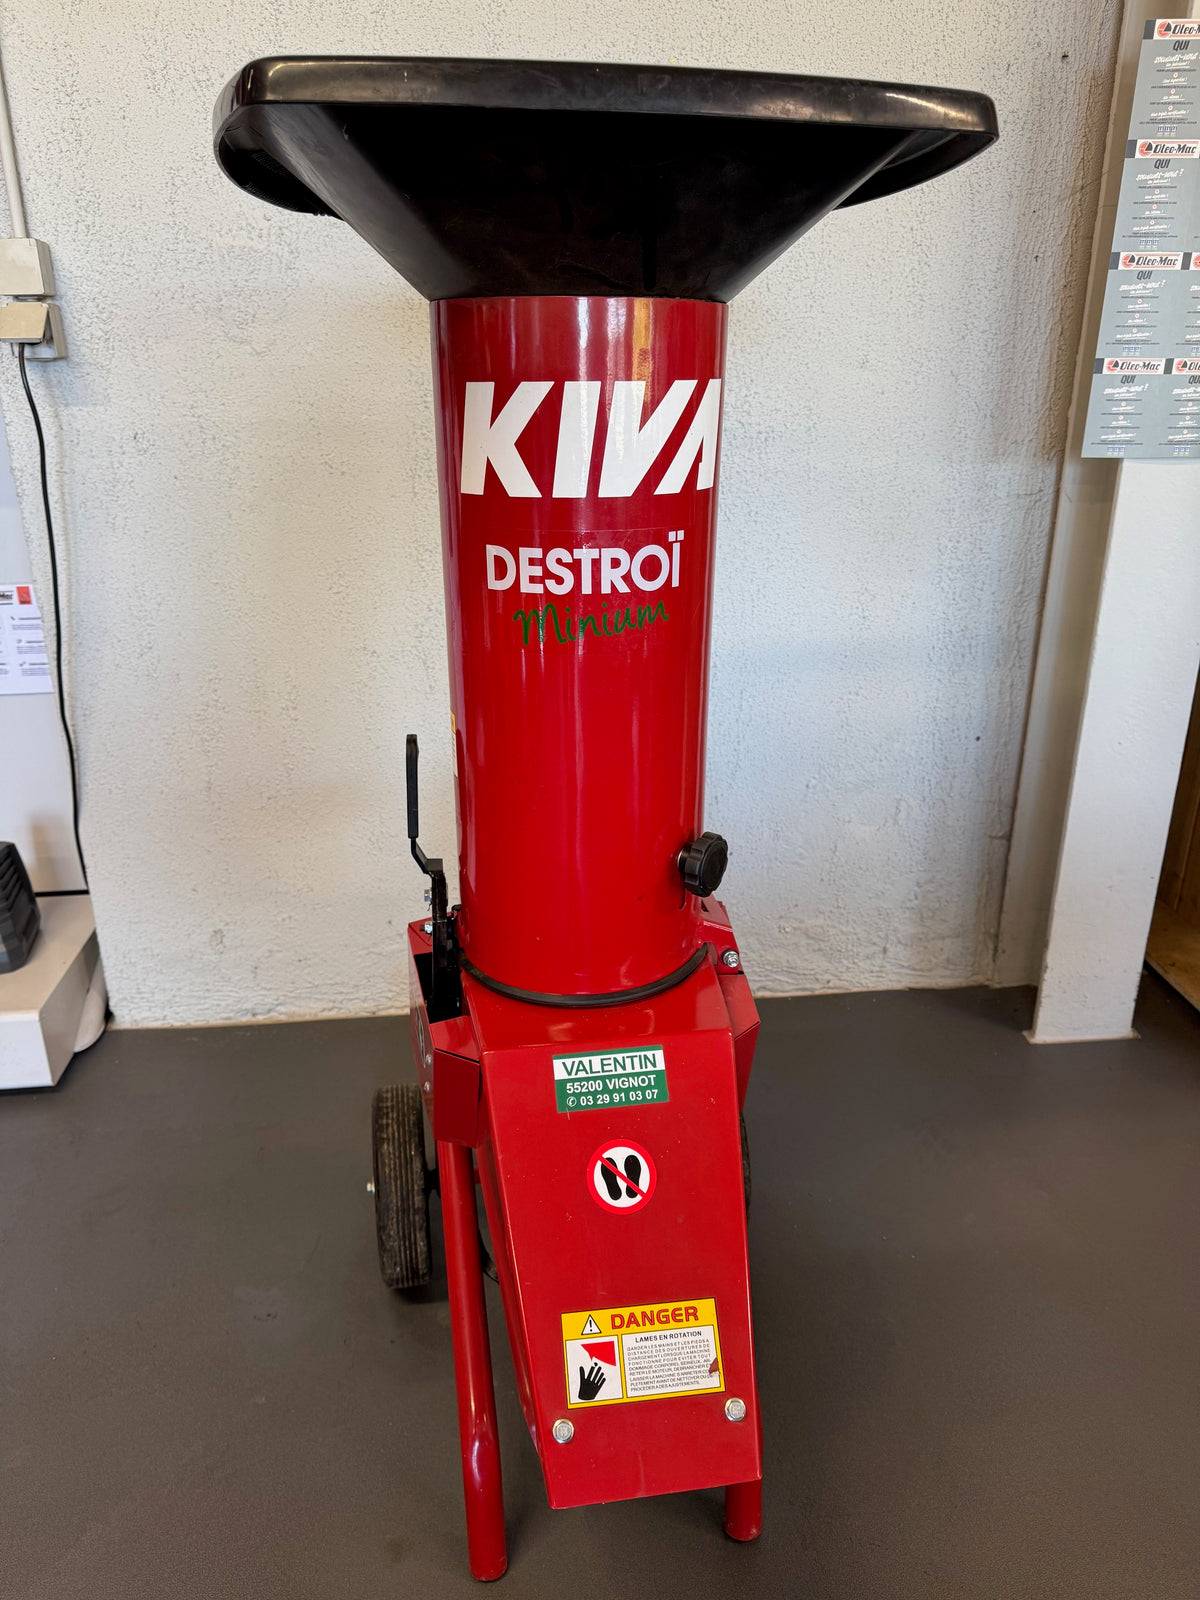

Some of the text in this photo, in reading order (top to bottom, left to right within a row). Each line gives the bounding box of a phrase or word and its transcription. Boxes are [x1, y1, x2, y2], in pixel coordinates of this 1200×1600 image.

[1172, 40, 1190, 51] QUI
[1153, 144, 1196, 154] Oleo-Mac
[1154, 159, 1171, 169] QUI
[1136, 256, 1178, 266] Oleo-Mac
[1136, 270, 1153, 280] QUI
[1120, 361, 1161, 371] Oleo-Mac
[1120, 375, 1137, 384] QUI
[461, 378, 721, 498] KIVA
[485, 529, 685, 595] DESTROÏ
[513, 600, 670, 646] Minium
[562, 1053, 657, 1076] VALENTIN
[566, 1075, 656, 1094] 55200 VIGNOT
[580, 1089, 659, 1106] 03 29 91 03 07
[611, 1306, 699, 1330] DANGER
[635, 1335, 658, 1343] LAMES
[669, 1330, 702, 1339] ROTATION
[666, 1344, 702, 1352] OUVERTURES
[628, 1359, 662, 1367] FONCTIONNE
